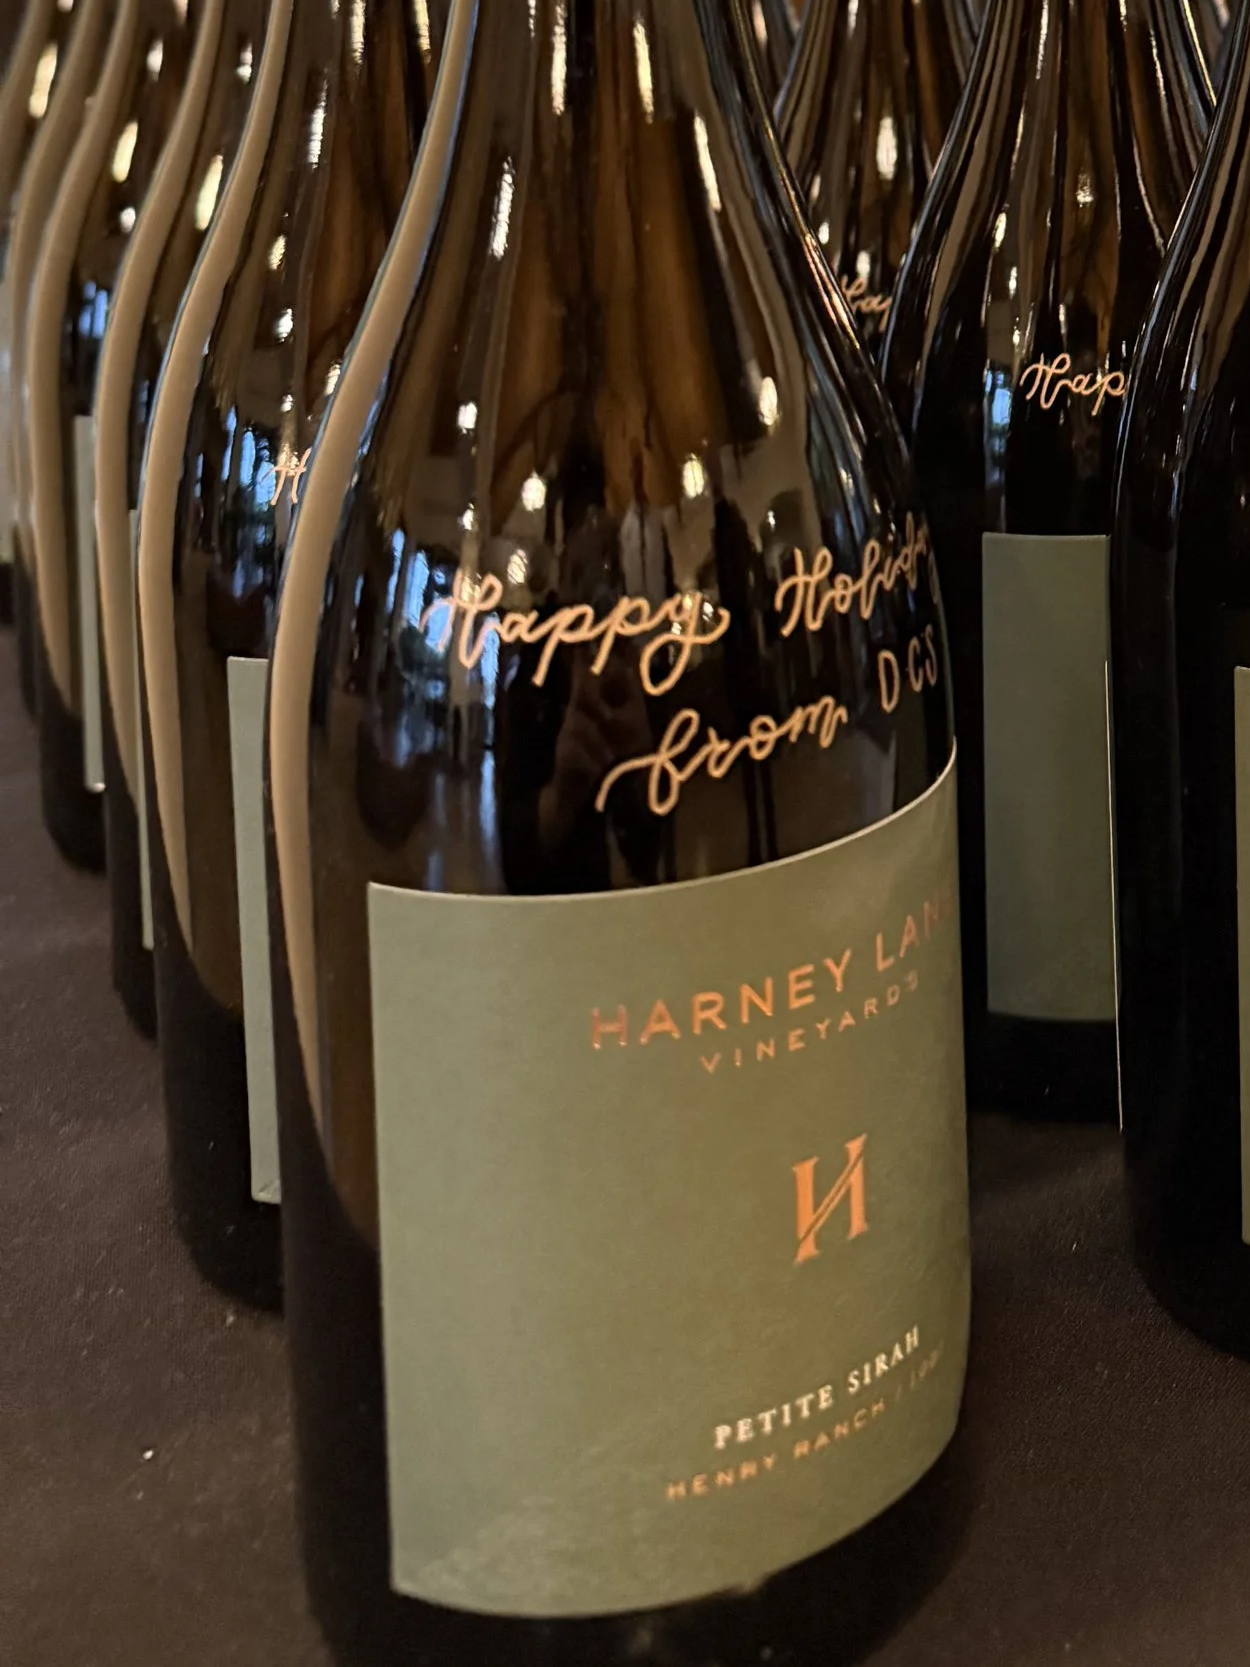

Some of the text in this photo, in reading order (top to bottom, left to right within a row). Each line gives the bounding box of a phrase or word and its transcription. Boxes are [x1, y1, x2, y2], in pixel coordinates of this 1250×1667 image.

[420, 568, 731, 697] Happy
[595, 694, 848, 816] from
[589, 946, 852, 1050] HARNEY
[698, 969, 919, 1074] VINEYARDS
[714, 1323, 920, 1451] PETITE SIRAH
[665, 1452, 778, 1502] HENRY
[793, 1397, 887, 1460] RANCH
